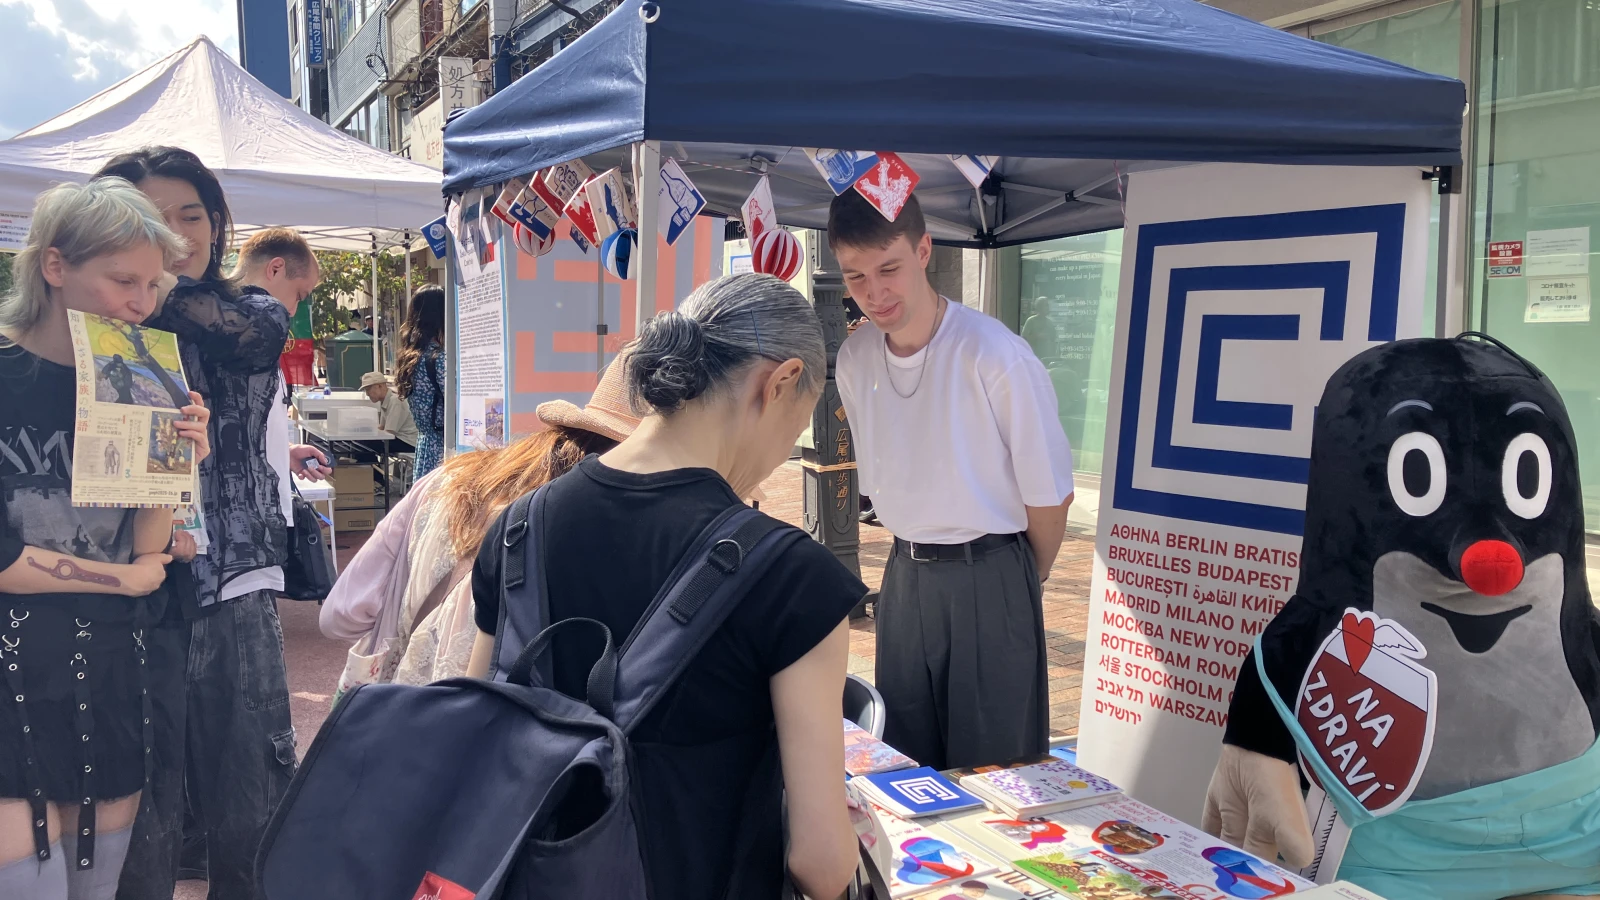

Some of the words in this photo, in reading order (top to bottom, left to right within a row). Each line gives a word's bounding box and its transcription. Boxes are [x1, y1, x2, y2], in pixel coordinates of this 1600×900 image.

[311, 1, 322, 62] 広尾本間クリニック
[1491, 266, 1521, 275] SECOM
[70, 312, 90, 432] 知られざる家族の物語
[137, 436, 143, 446] 2
[125, 468, 131, 479] 3
[1108, 545, 1191, 574] BRUXELLES
[1197, 561, 1293, 593] BUDAPEST
[1166, 532, 1228, 557] BERLIN
[1234, 543, 1301, 569] BRATIS
[1106, 567, 1188, 598] BUCUREȘTI
[1192, 584, 1236, 608] القاهرة
[1104, 588, 1161, 615] MADRID
[1165, 603, 1234, 631] MILANO
[1100, 632, 1191, 670] ROTTERDAM
[1169, 627, 1210, 650] NEW
[1096, 677, 1124, 697] אביב
[1099, 654, 1121, 675] 서울
[1124, 663, 1223, 702] STOCKHOLM
[1126, 684, 1144, 704] תל
[1095, 699, 1142, 725] ירושלים
[1347, 687, 1395, 748] NA
[1303, 671, 1395, 804] ZDRAVÍ
[1096, 852, 1136, 872] KRTEK
